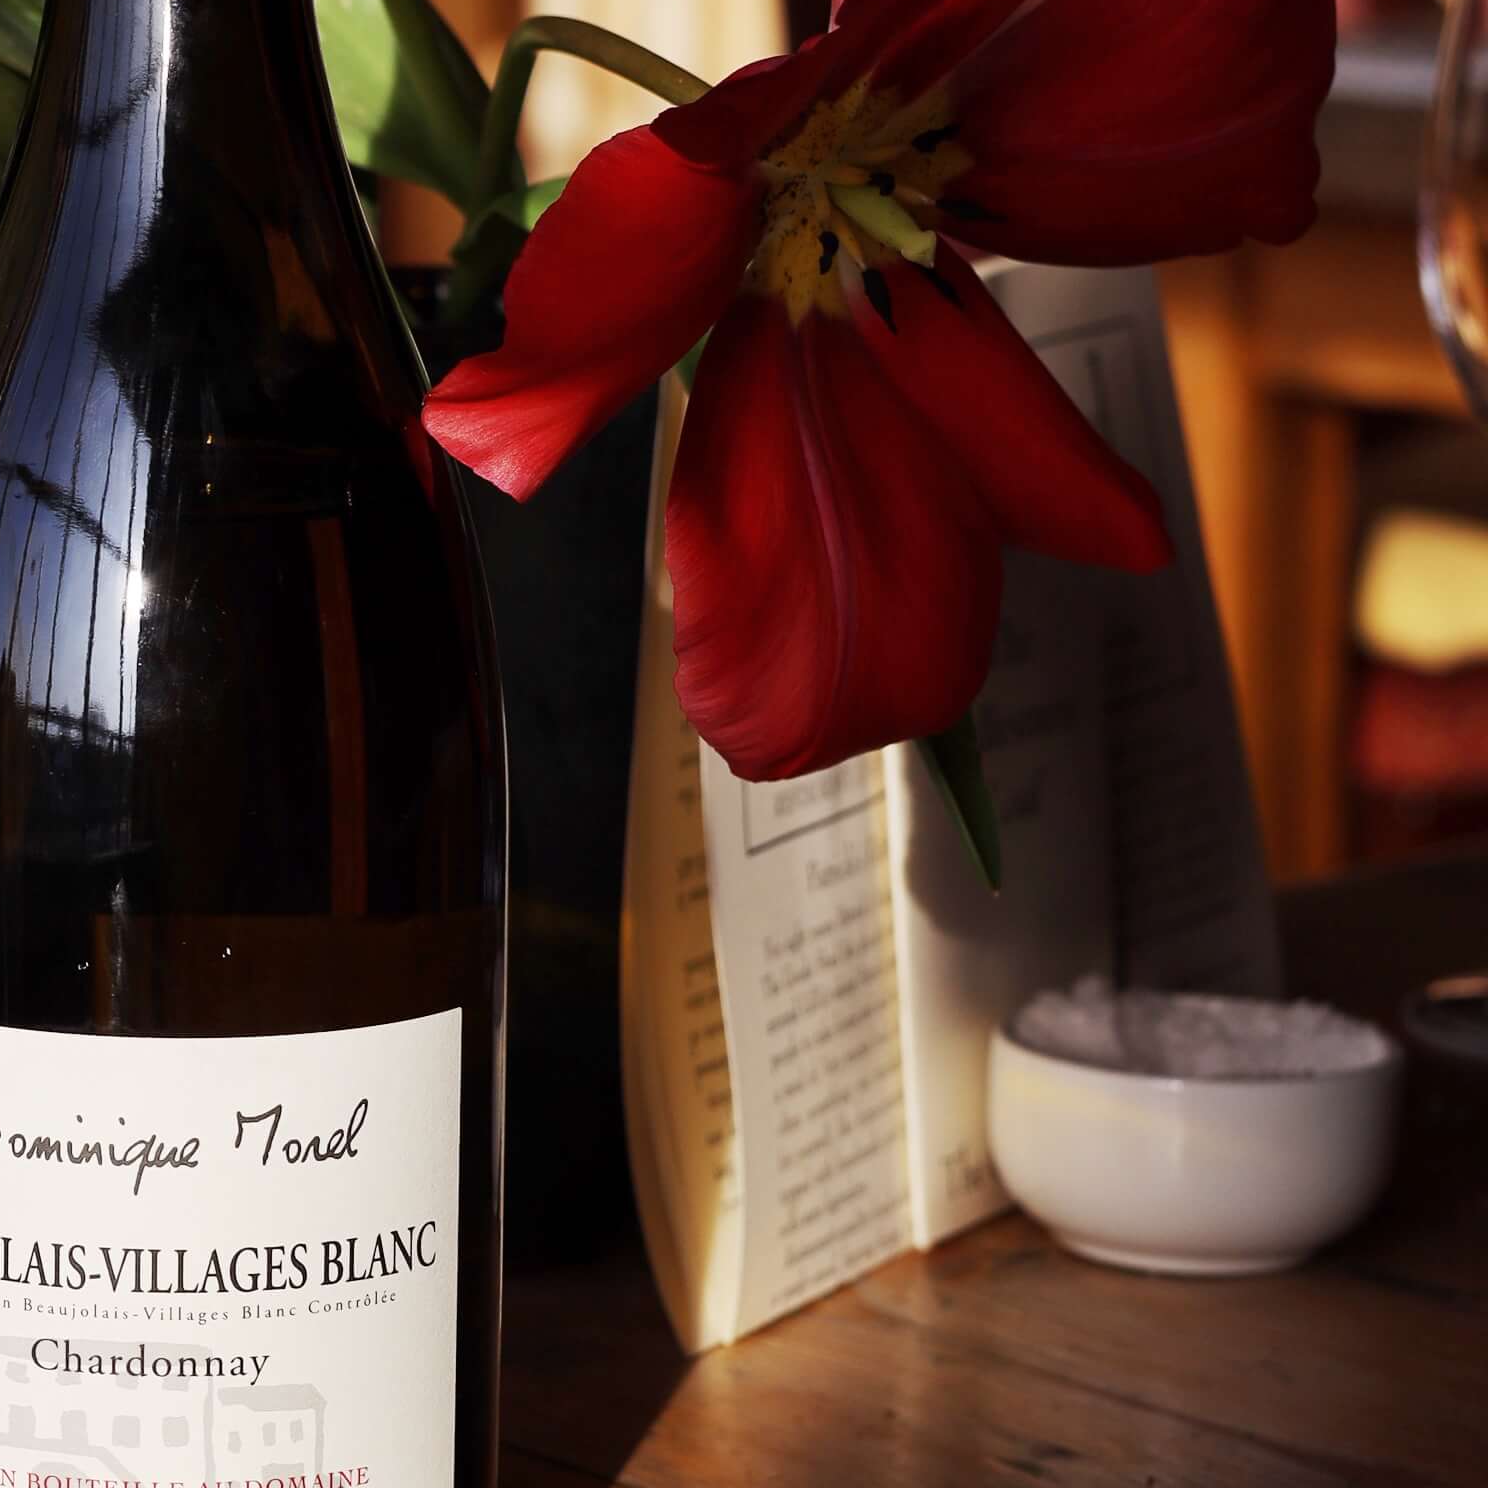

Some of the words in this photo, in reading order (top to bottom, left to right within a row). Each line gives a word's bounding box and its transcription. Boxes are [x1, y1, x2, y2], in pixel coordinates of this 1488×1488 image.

[235, 1098, 369, 1166] Morel
[321, 1221, 436, 1284] BLANC
[23, 1298, 230, 1325] Beaujolais-Villages
[242, 1303, 297, 1319] Blanc
[307, 1290, 397, 1314] Contrôlée
[31, 1338, 269, 1385] Chardonnay
